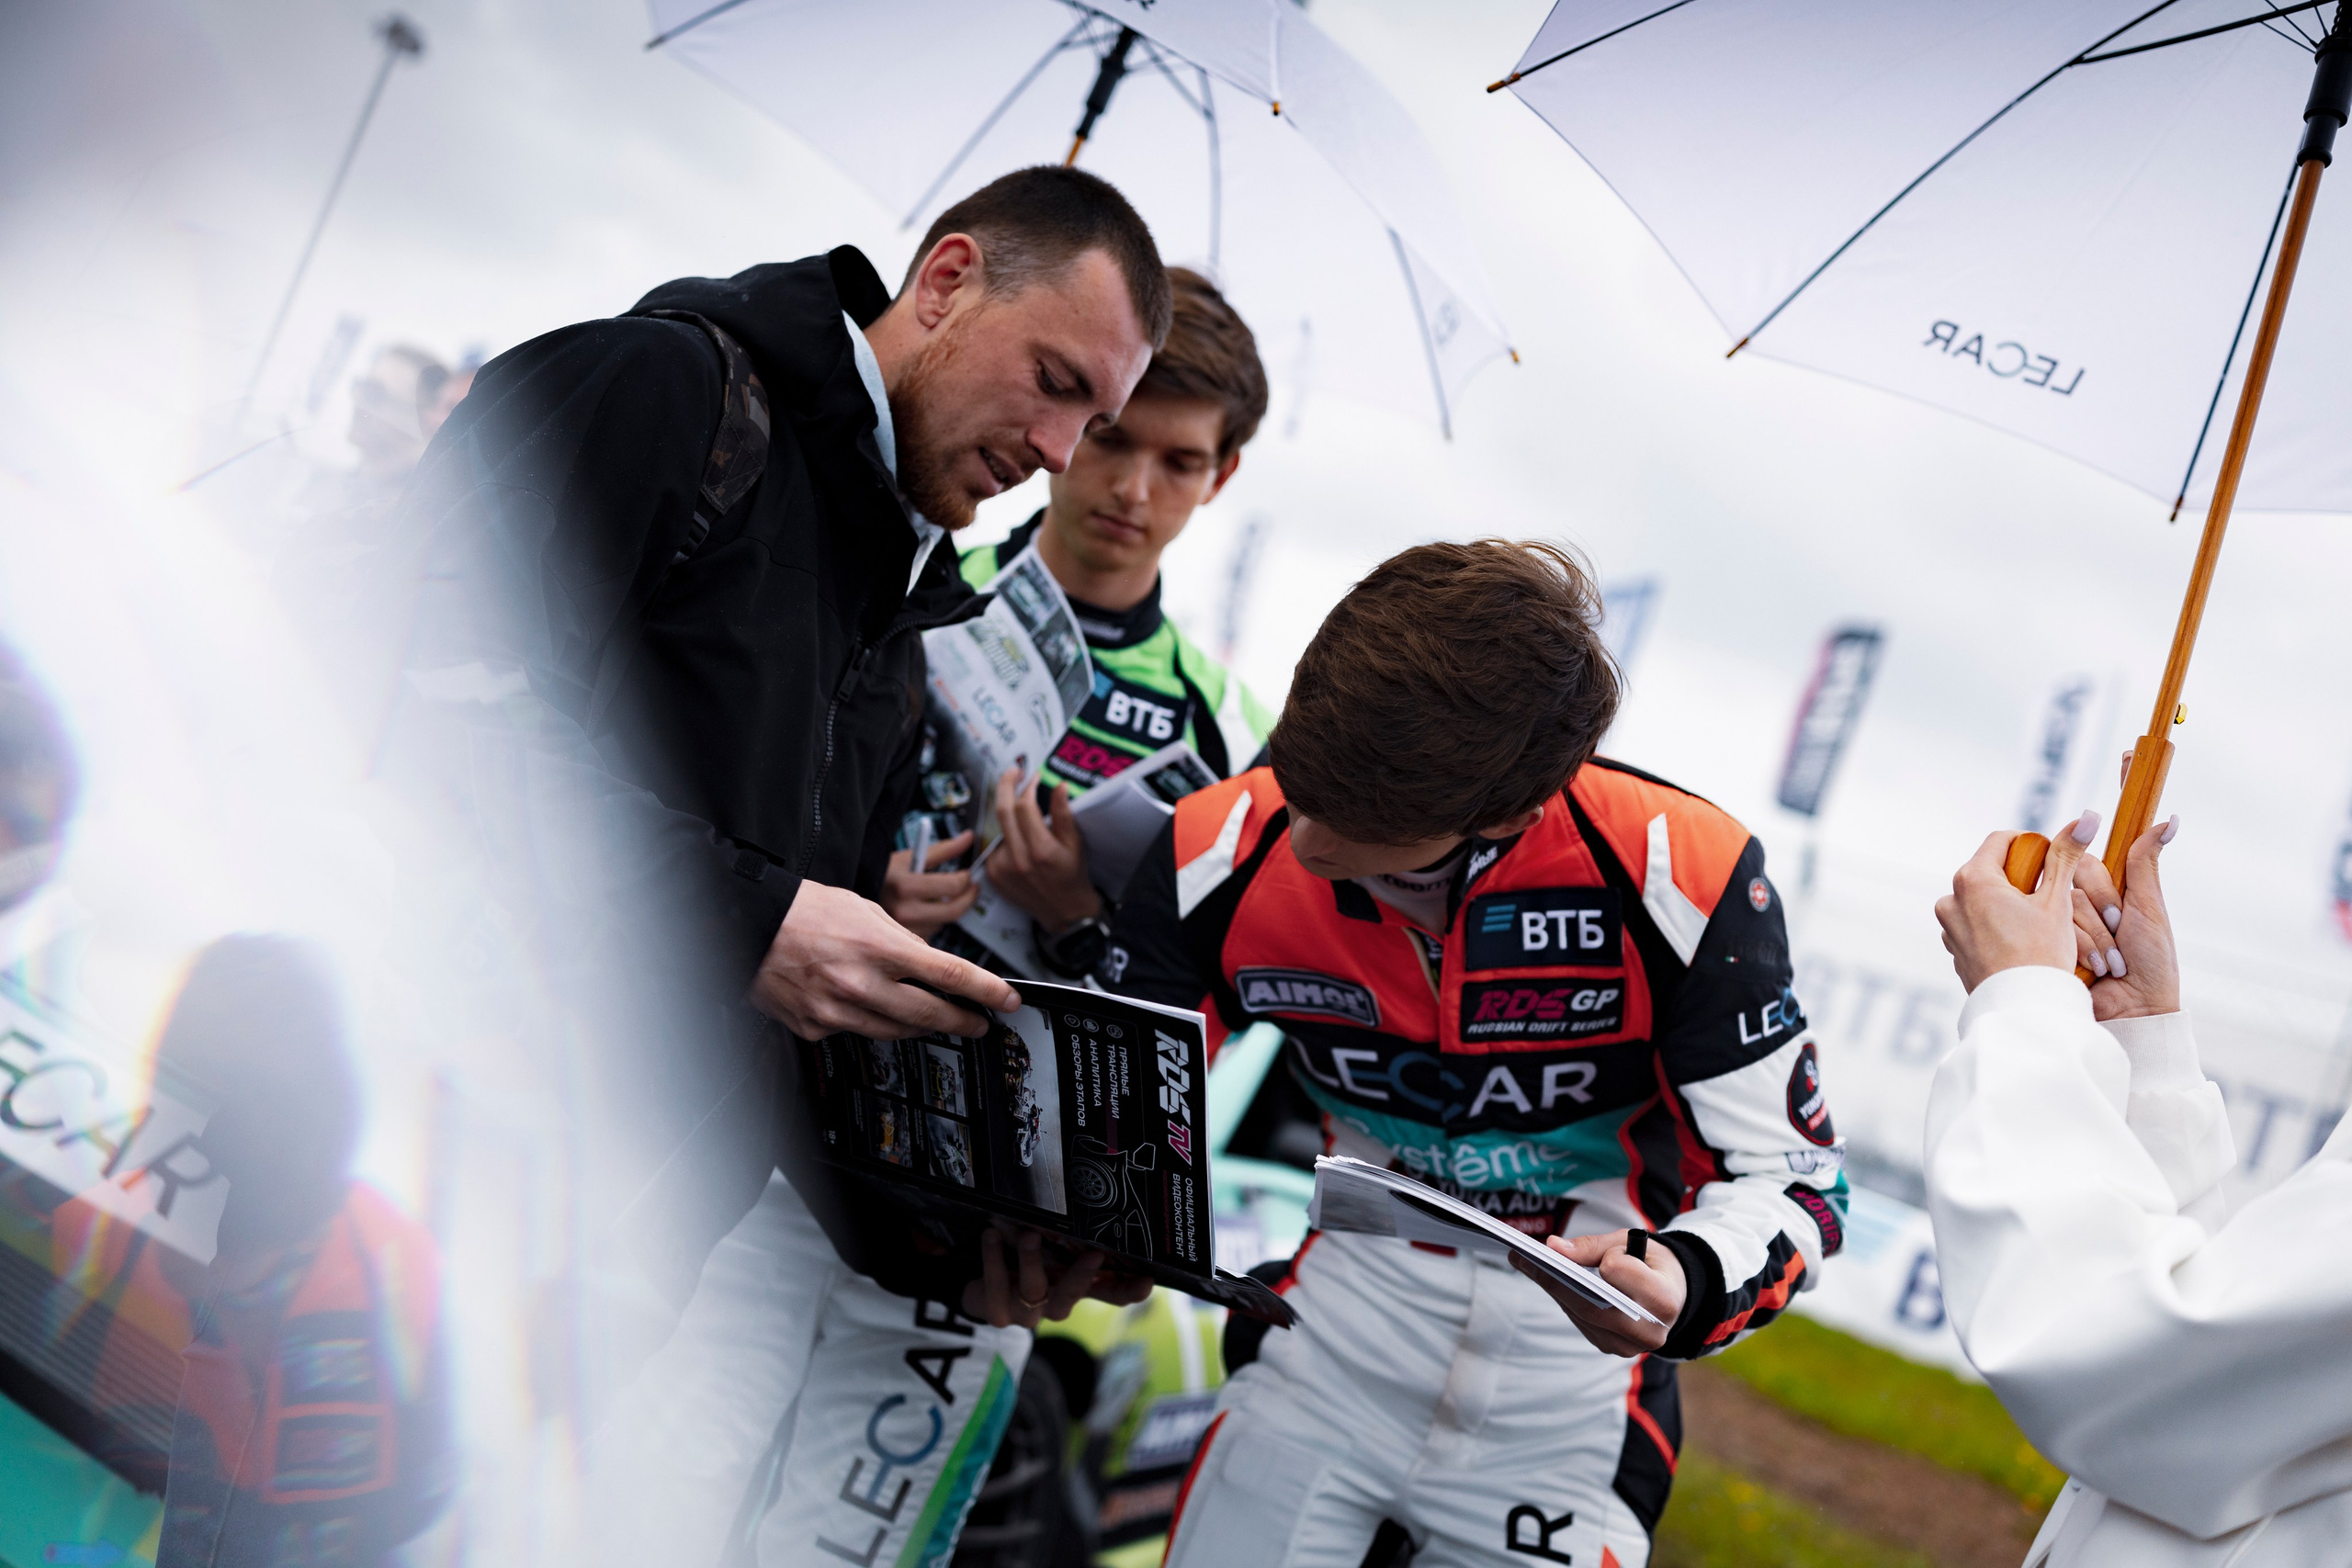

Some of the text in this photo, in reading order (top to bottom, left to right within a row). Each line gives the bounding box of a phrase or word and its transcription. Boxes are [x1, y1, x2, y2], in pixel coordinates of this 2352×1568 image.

[1104, 689, 1176, 740] ВТБ
[1521, 908, 1605, 952] ВТБ
[1467, 1016, 1617, 1034] RUSSIAN DRIFT SERIES
[1570, 987, 1620, 1011] GP
[821, 1035, 834, 1077] АЙТЕСЬ
[1071, 1033, 1086, 1127] ОБЗОРЫ ЭТАПОВ
[1089, 1038, 1102, 1108] АНАЛИТИКА
[1107, 1044, 1120, 1120] ТРАНСЛЯЦИИ
[1118, 1045, 1130, 1097] ПРЯМЫЕ
[1289, 1034, 1597, 1123] LECAR
[0, 1030, 220, 1220] ECAR
[828, 1130, 837, 1145] 18+
[1172, 1172, 1184, 1258] ВИДЕОКОНТЕНТ
[1184, 1177, 1199, 1262] ОФИЦИАЛЬНЫЙ
[1506, 1504, 1575, 1567] R
